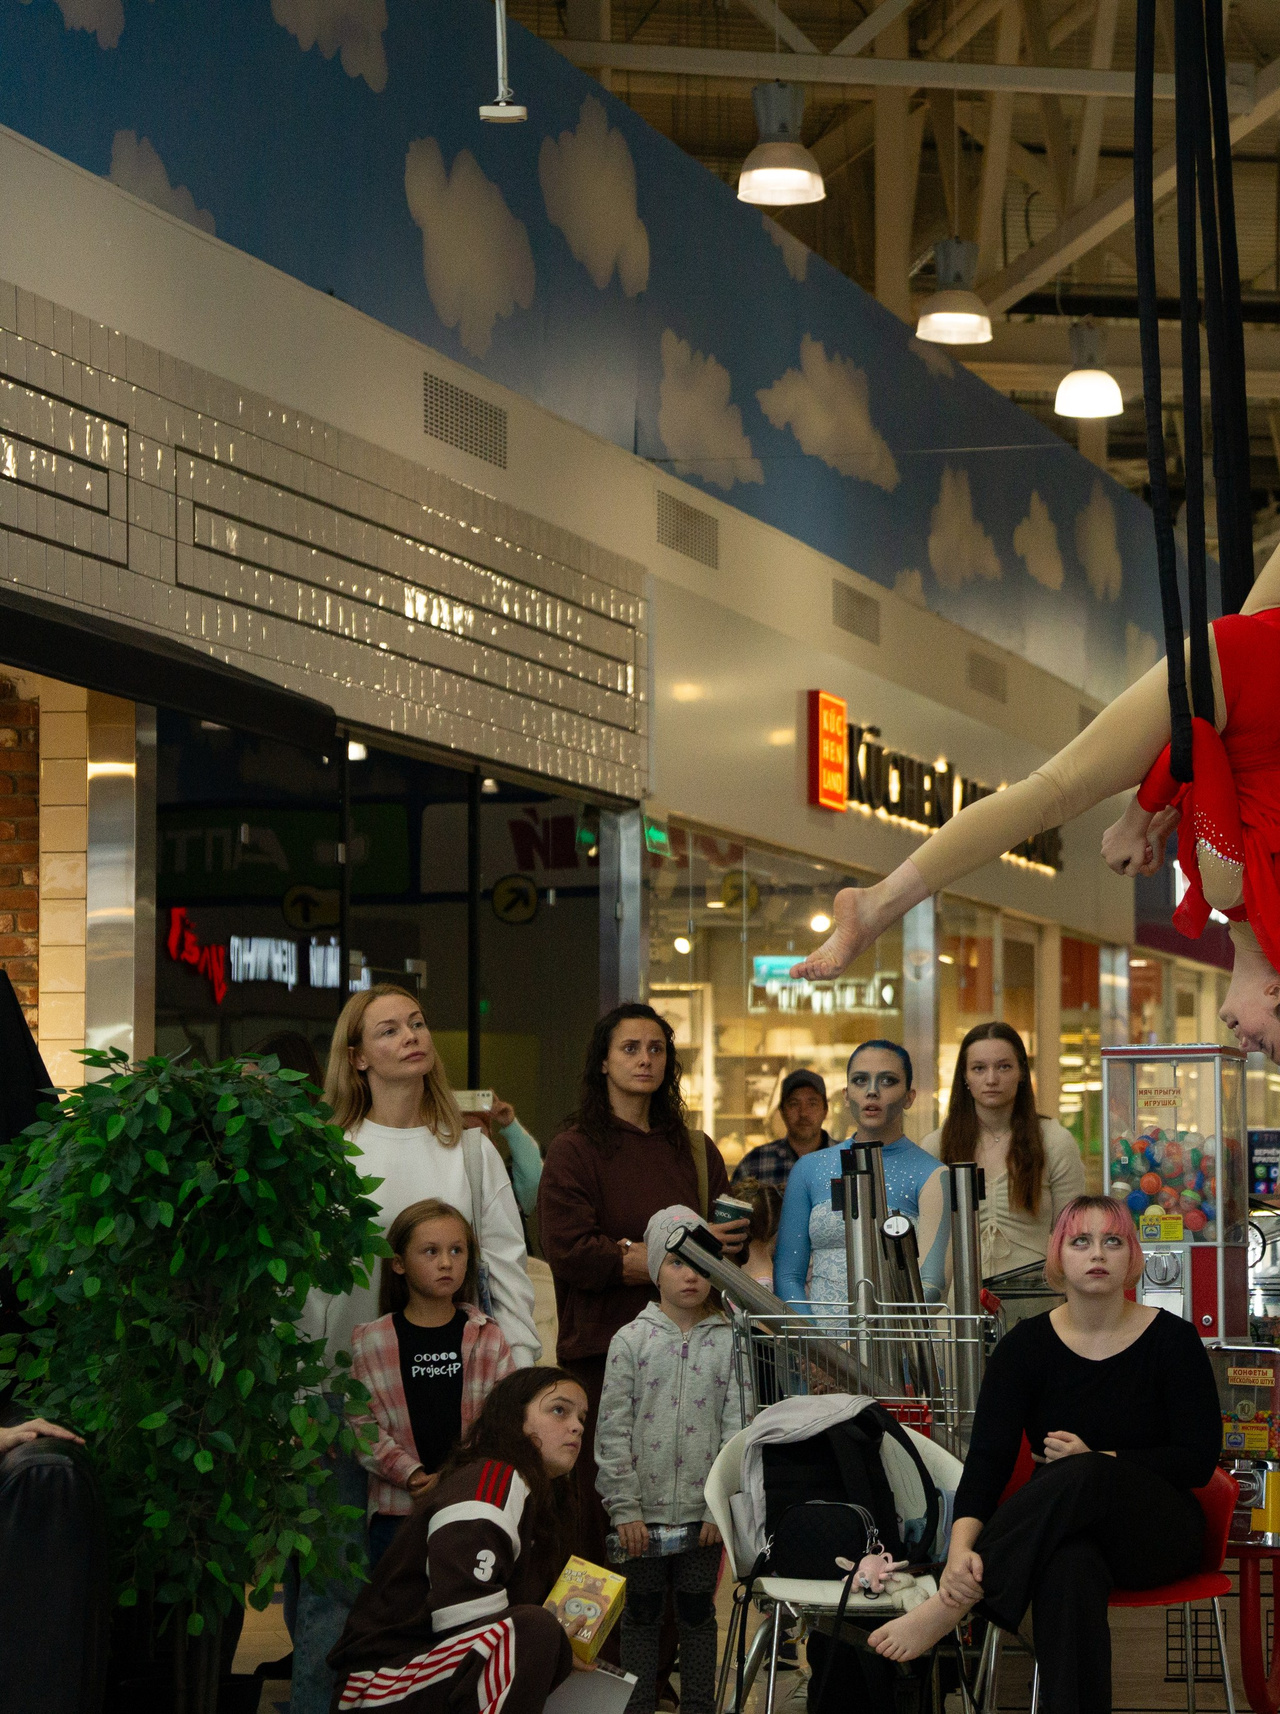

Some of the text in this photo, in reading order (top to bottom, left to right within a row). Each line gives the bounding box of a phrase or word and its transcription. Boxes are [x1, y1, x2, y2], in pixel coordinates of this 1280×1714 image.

[822, 708, 843, 736] KÜC
[822, 739, 842, 763] HEN
[822, 770, 842, 793] LAND
[1229, 1376, 1260, 1384] НЕСКОЛЬКО
[1233, 1368, 1268, 1376] КОНФЕТЫ
[1238, 1403, 1251, 1415] 10
[473, 1549, 496, 1582] 3
